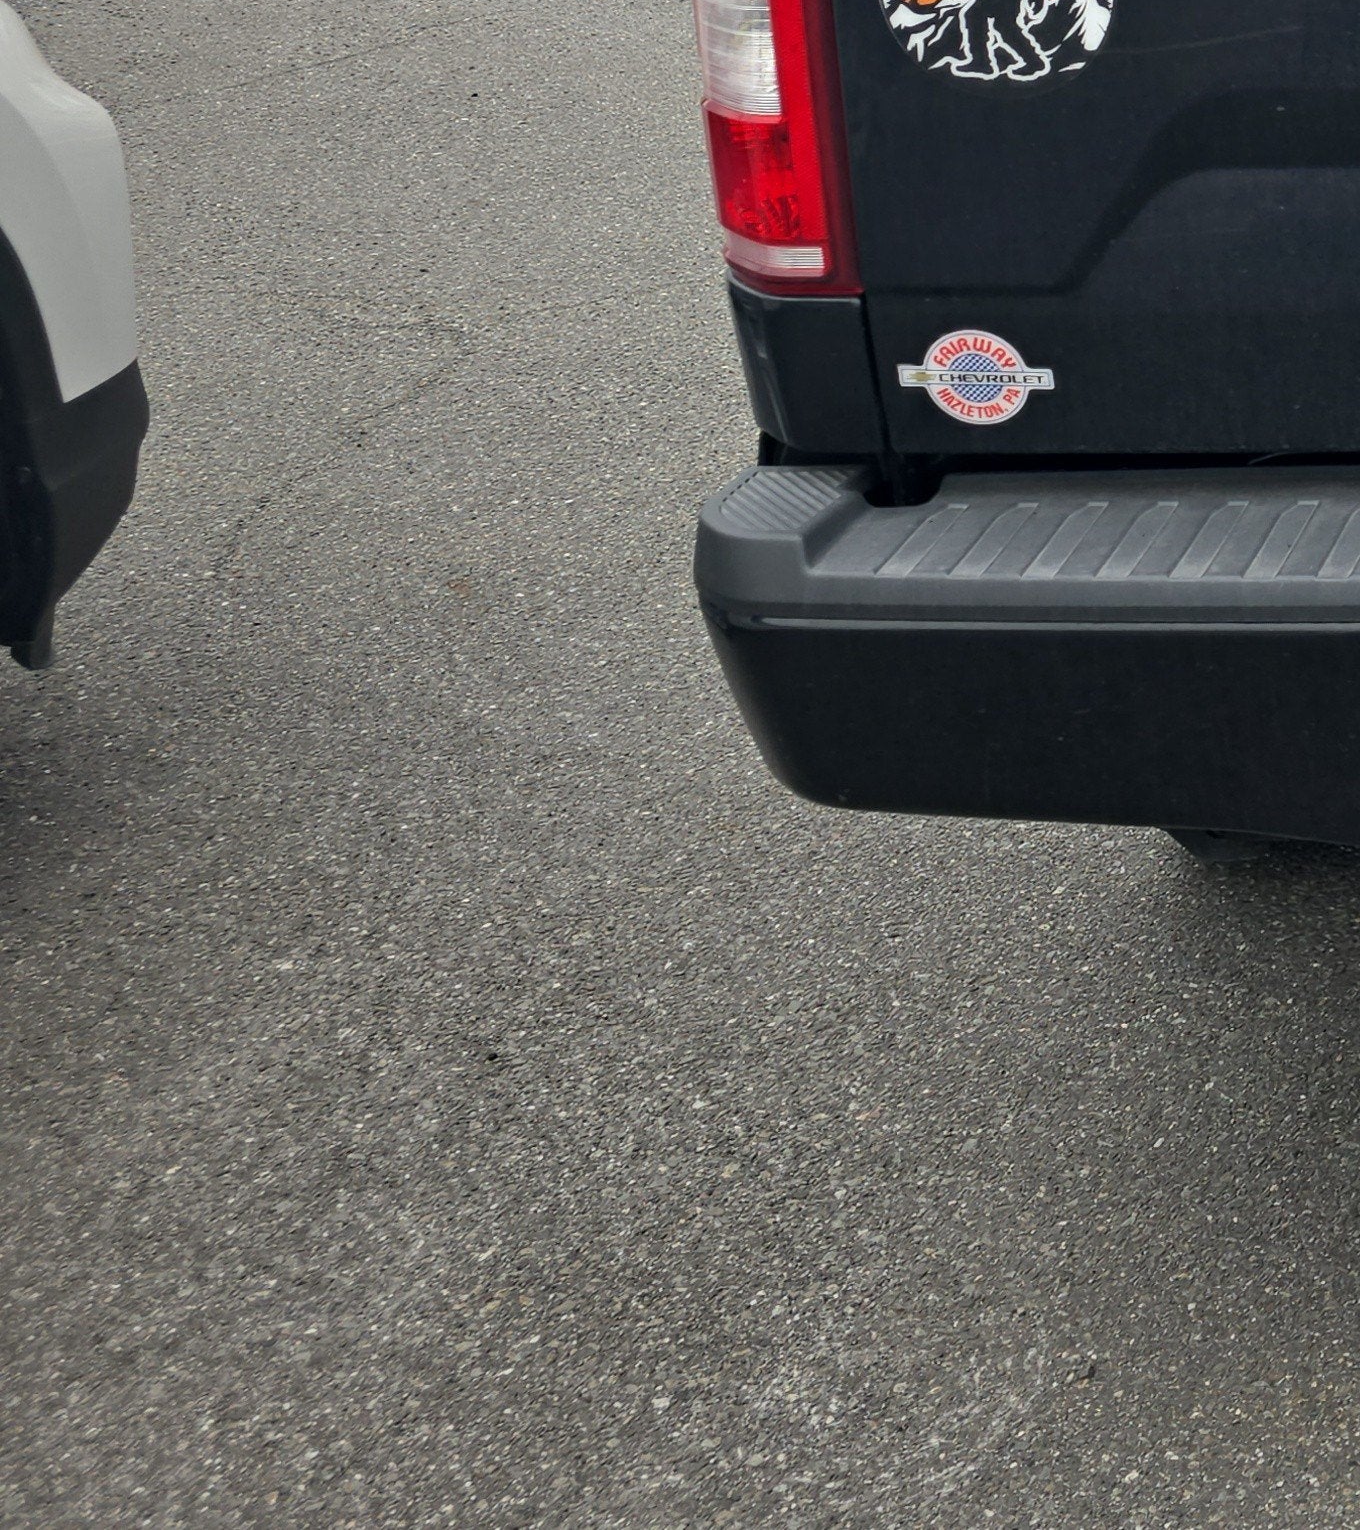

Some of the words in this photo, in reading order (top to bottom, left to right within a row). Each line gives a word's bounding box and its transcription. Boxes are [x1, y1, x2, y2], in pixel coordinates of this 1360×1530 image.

[933, 337, 1016, 369] FAIRWAY
[939, 373, 1044, 384] CHEVROLET
[1003, 388, 1021, 405] PA
